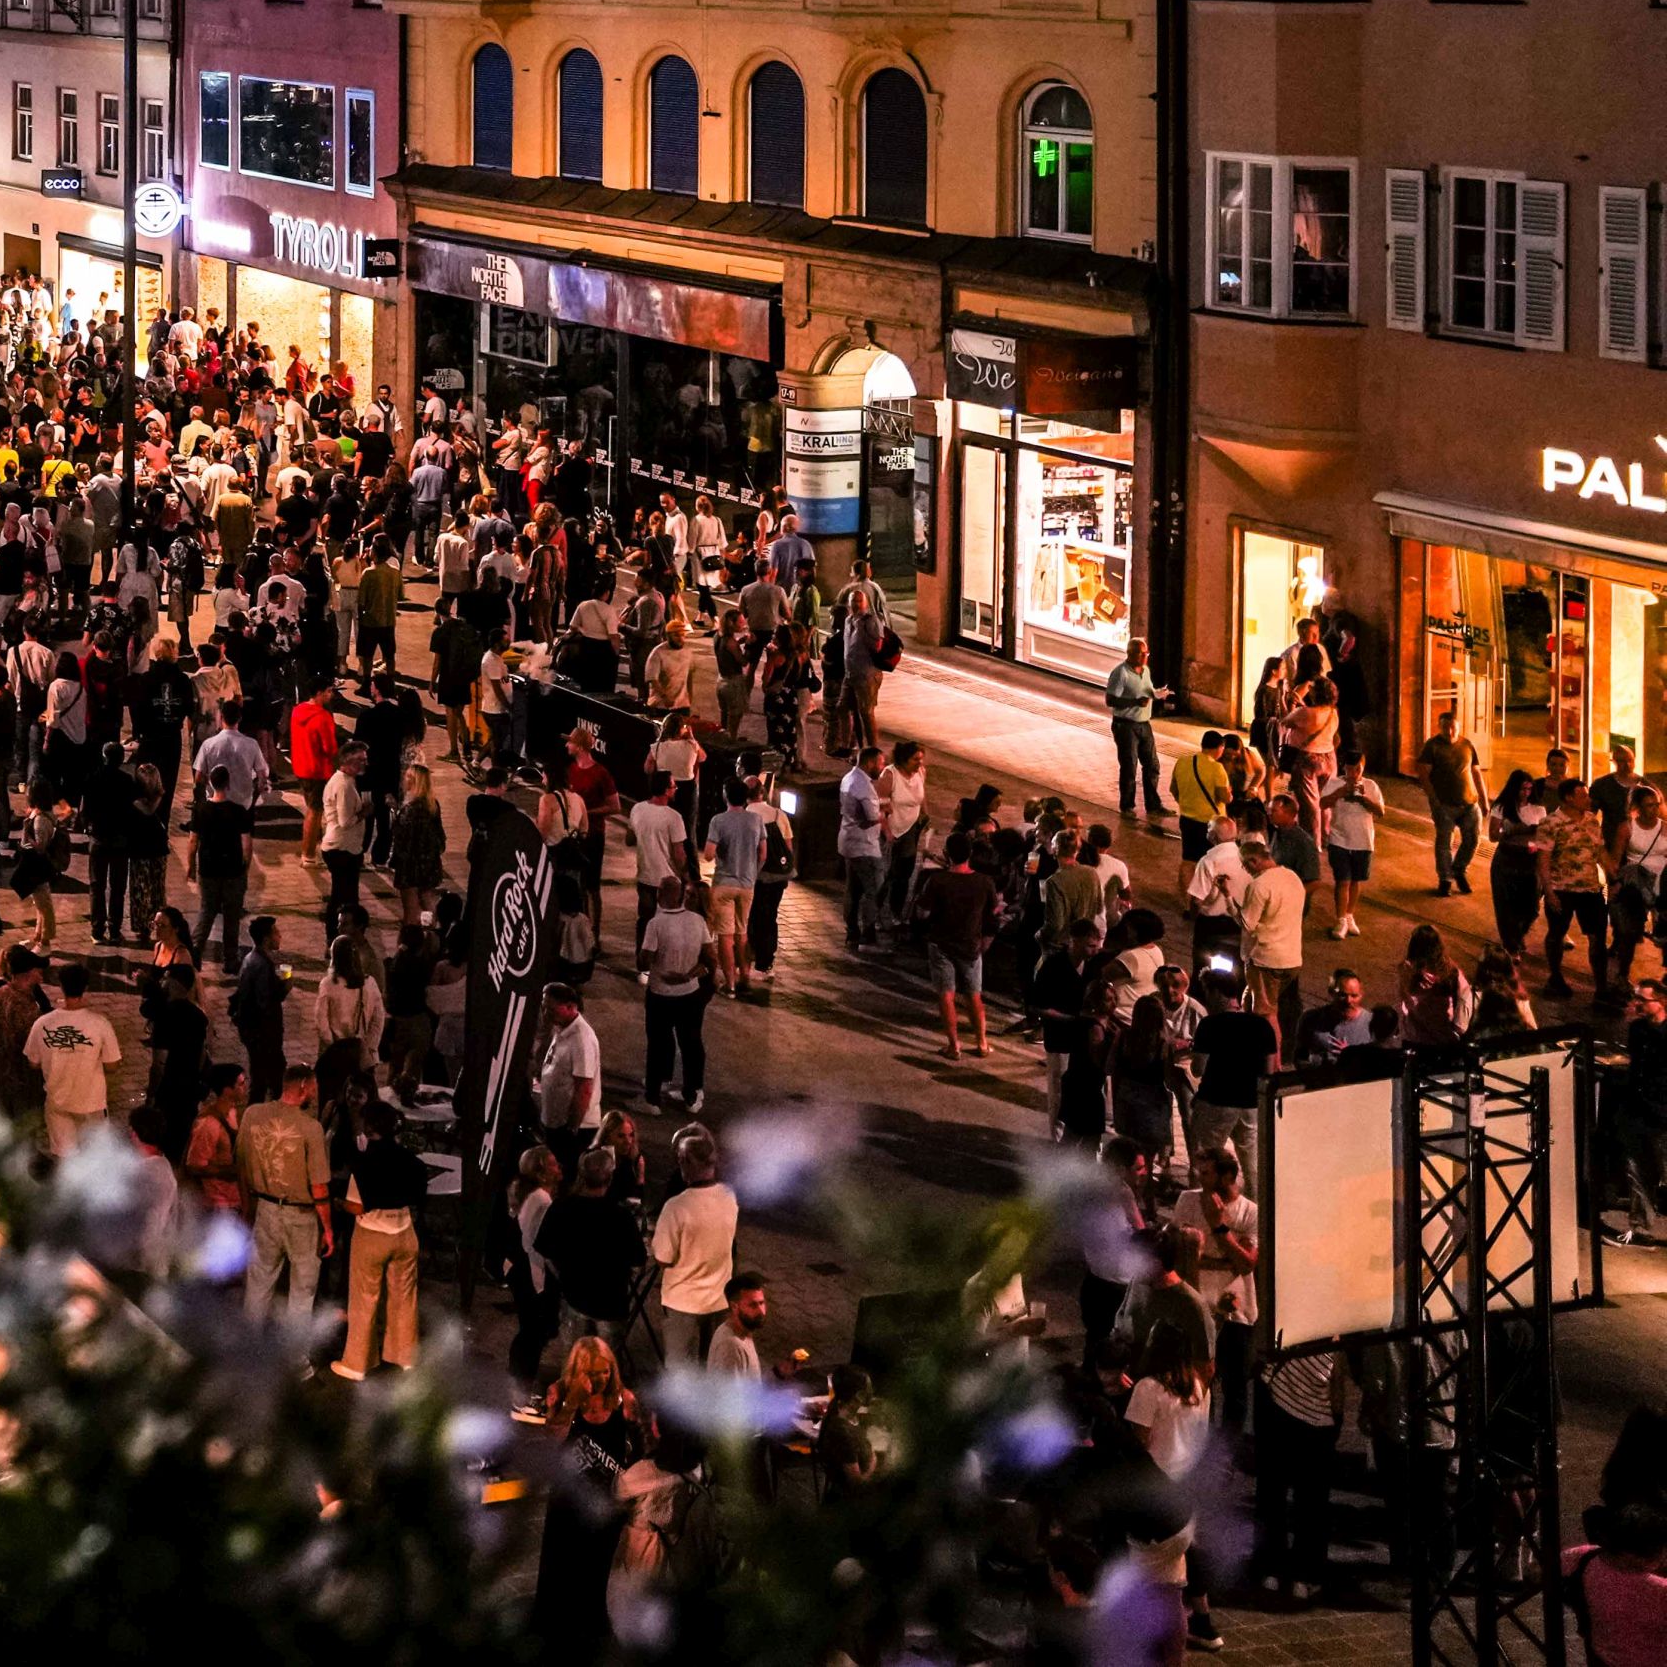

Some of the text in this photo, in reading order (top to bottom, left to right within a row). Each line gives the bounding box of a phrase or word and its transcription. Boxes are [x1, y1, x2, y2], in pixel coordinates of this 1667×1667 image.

[44, 178, 80, 190] ecco
[485, 252, 506, 271] THE
[471, 266, 507, 288] NORTH
[480, 284, 507, 304] FACE
[802, 435, 839, 449] KRAL
[890, 447, 908, 456] THE
[878, 455, 908, 465] NORTH
[886, 463, 908, 472] FACE
[517, 921, 530, 960] CAFE
